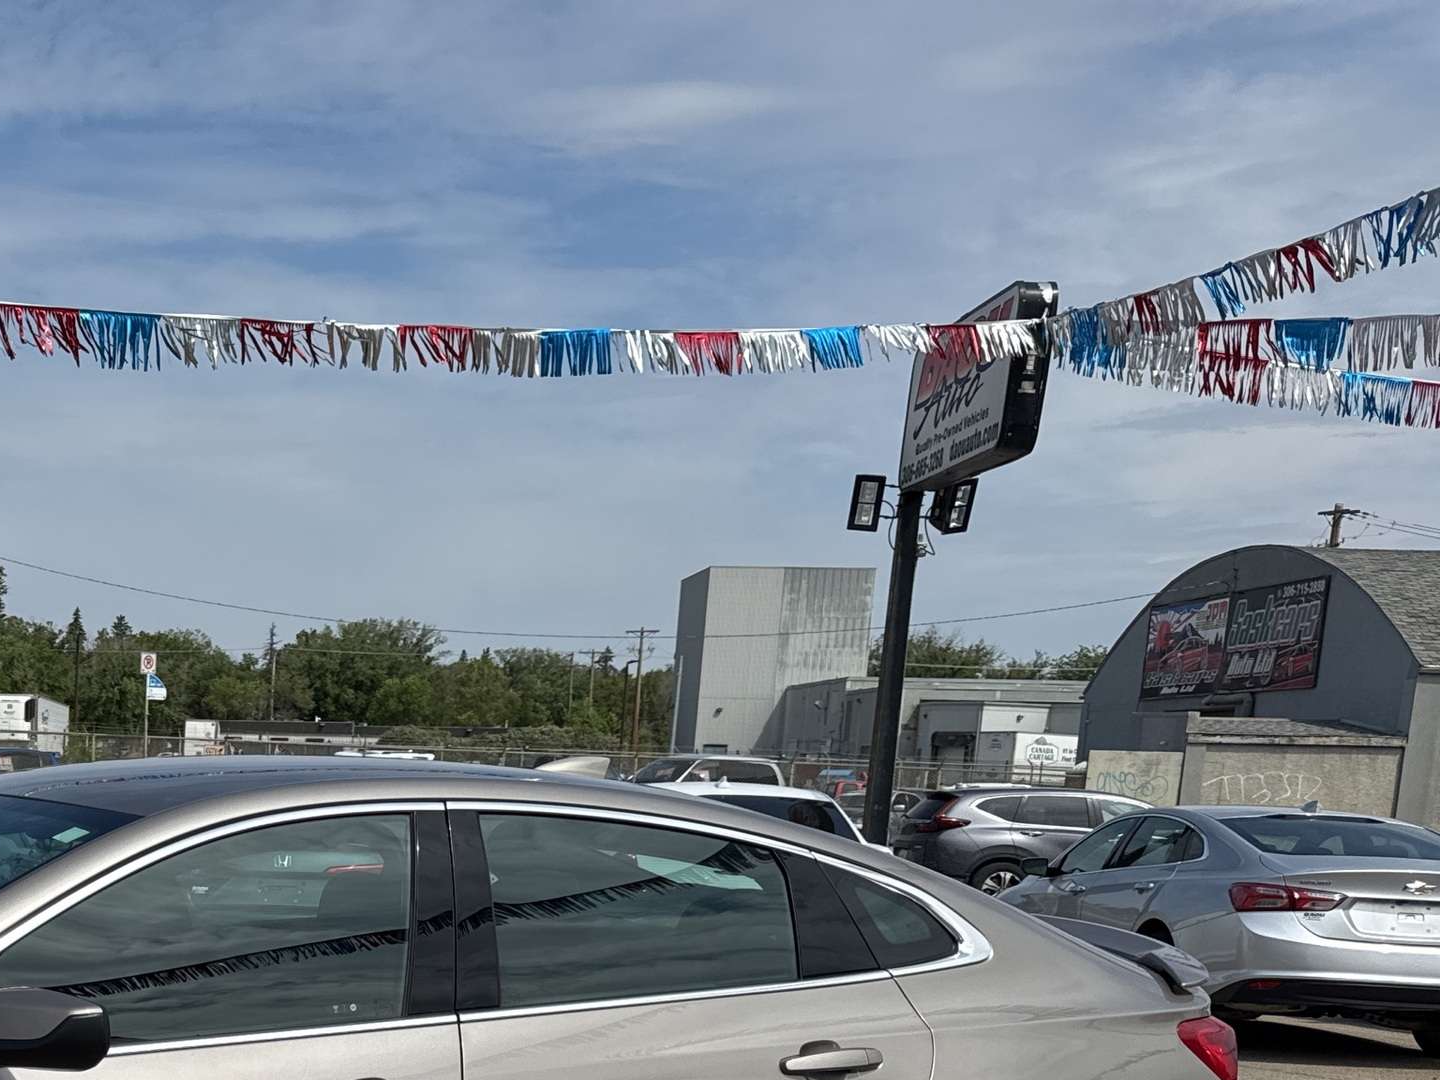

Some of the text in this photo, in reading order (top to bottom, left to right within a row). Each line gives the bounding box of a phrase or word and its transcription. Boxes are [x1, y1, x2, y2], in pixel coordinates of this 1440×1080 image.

[913, 372, 985, 441] Auto
[915, 407, 990, 456] Quality Pre-Owned Vehicles
[949, 422, 1000, 462] daouauto.com
[1226, 654, 1254, 676] Auto
[1180, 684, 1196, 693] Ltd
[1029, 753, 1054, 761] CARTAGE
